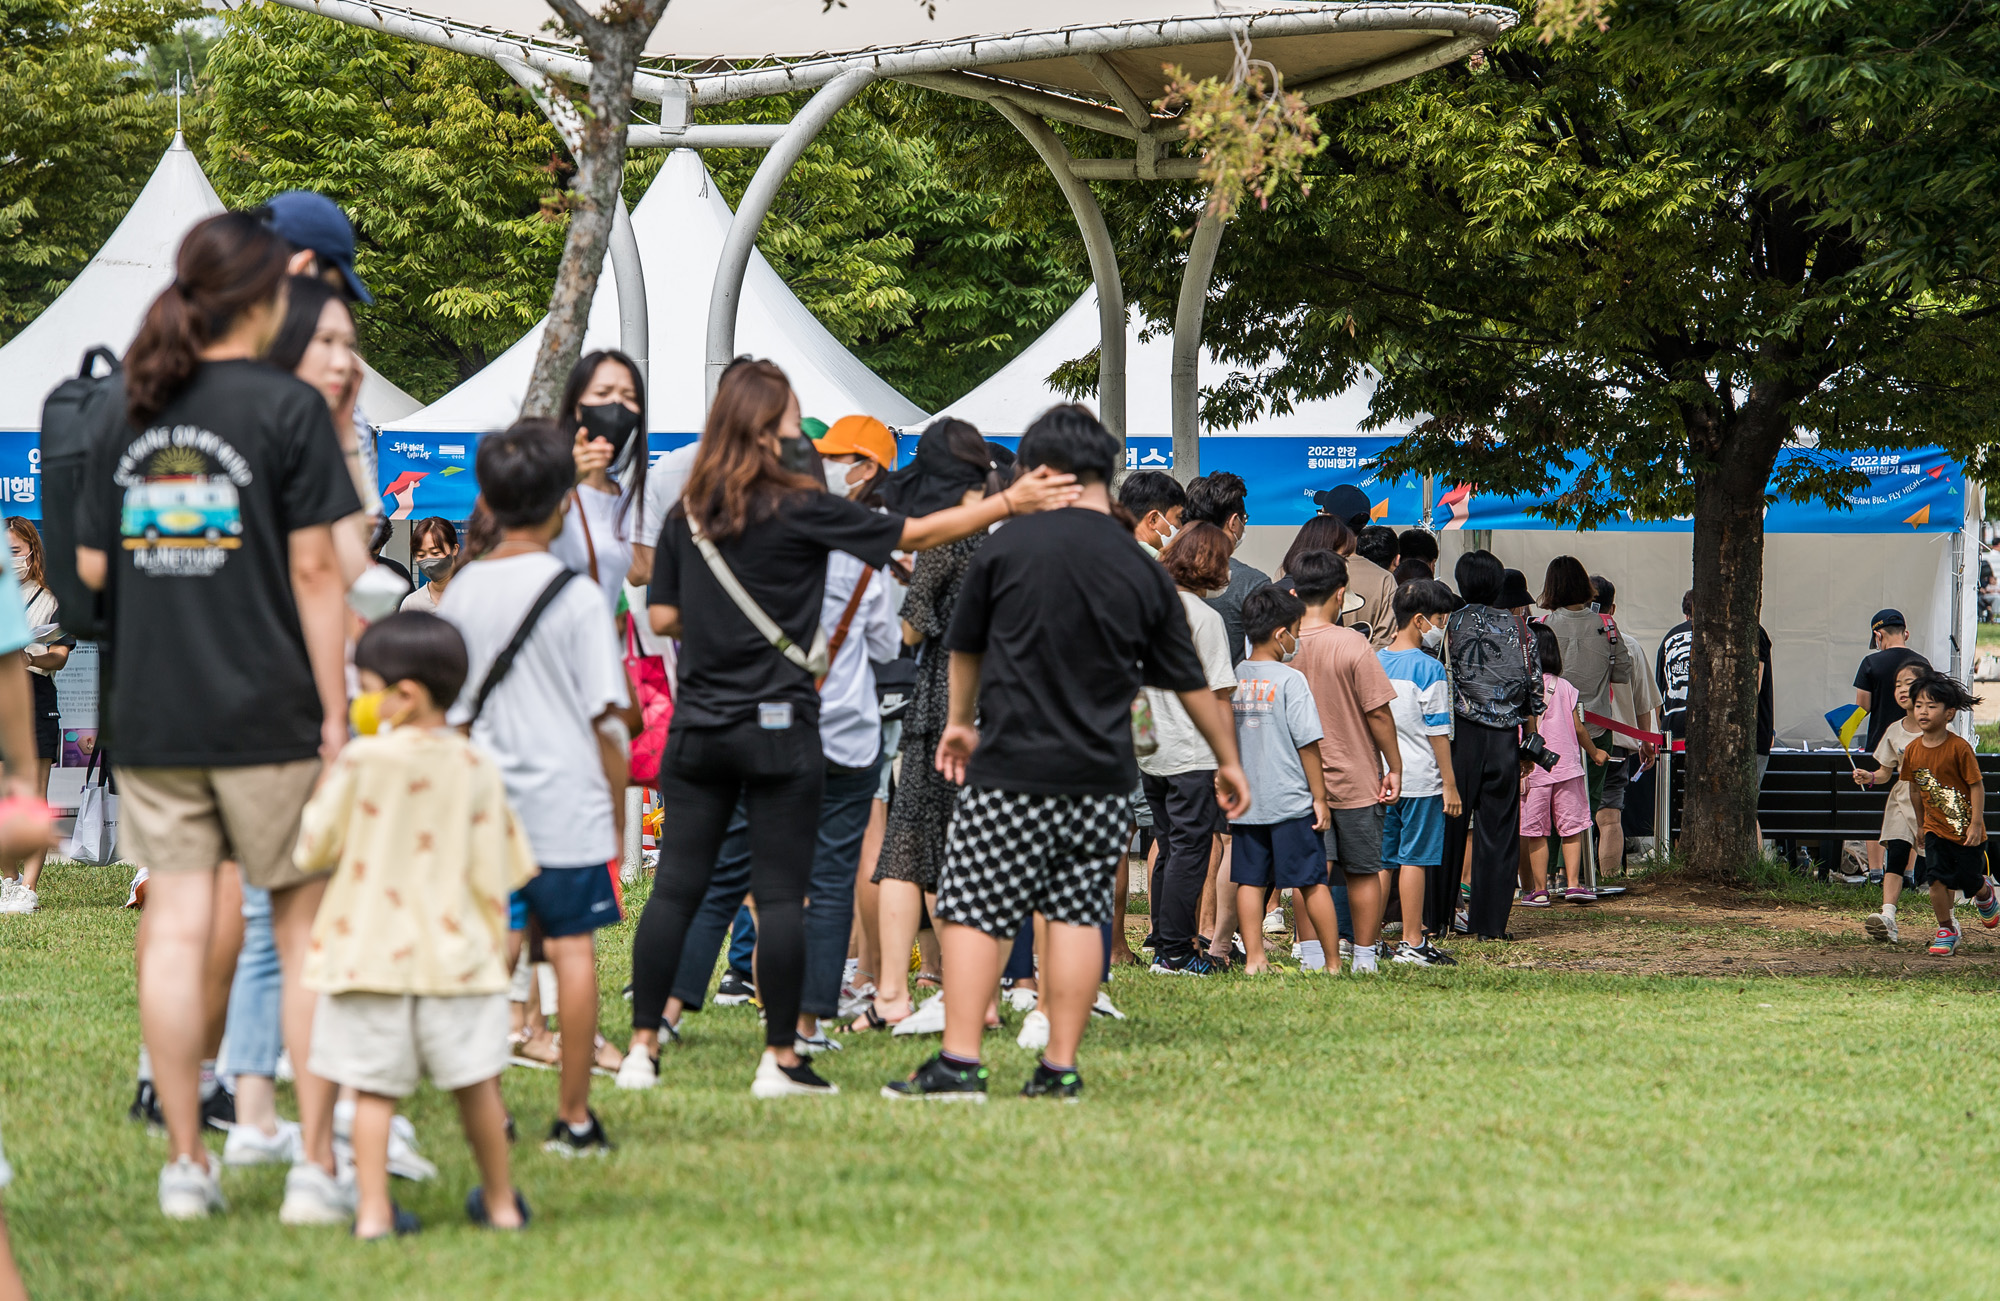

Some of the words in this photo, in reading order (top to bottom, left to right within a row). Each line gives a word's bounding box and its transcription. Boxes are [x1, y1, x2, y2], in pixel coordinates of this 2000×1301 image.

[1308, 446, 1336, 456] 2022
[1336, 446, 1357, 457] 한강
[1307, 458, 1357, 469] 종이비행기
[1850, 456, 1879, 467] 2022
[1880, 455, 1901, 465] 한강
[1900, 464, 1921, 475] 축제
[1844, 494, 1871, 505] DREAM
[1872, 495, 1888, 505] BIG,
[1888, 489, 1902, 502] FLY
